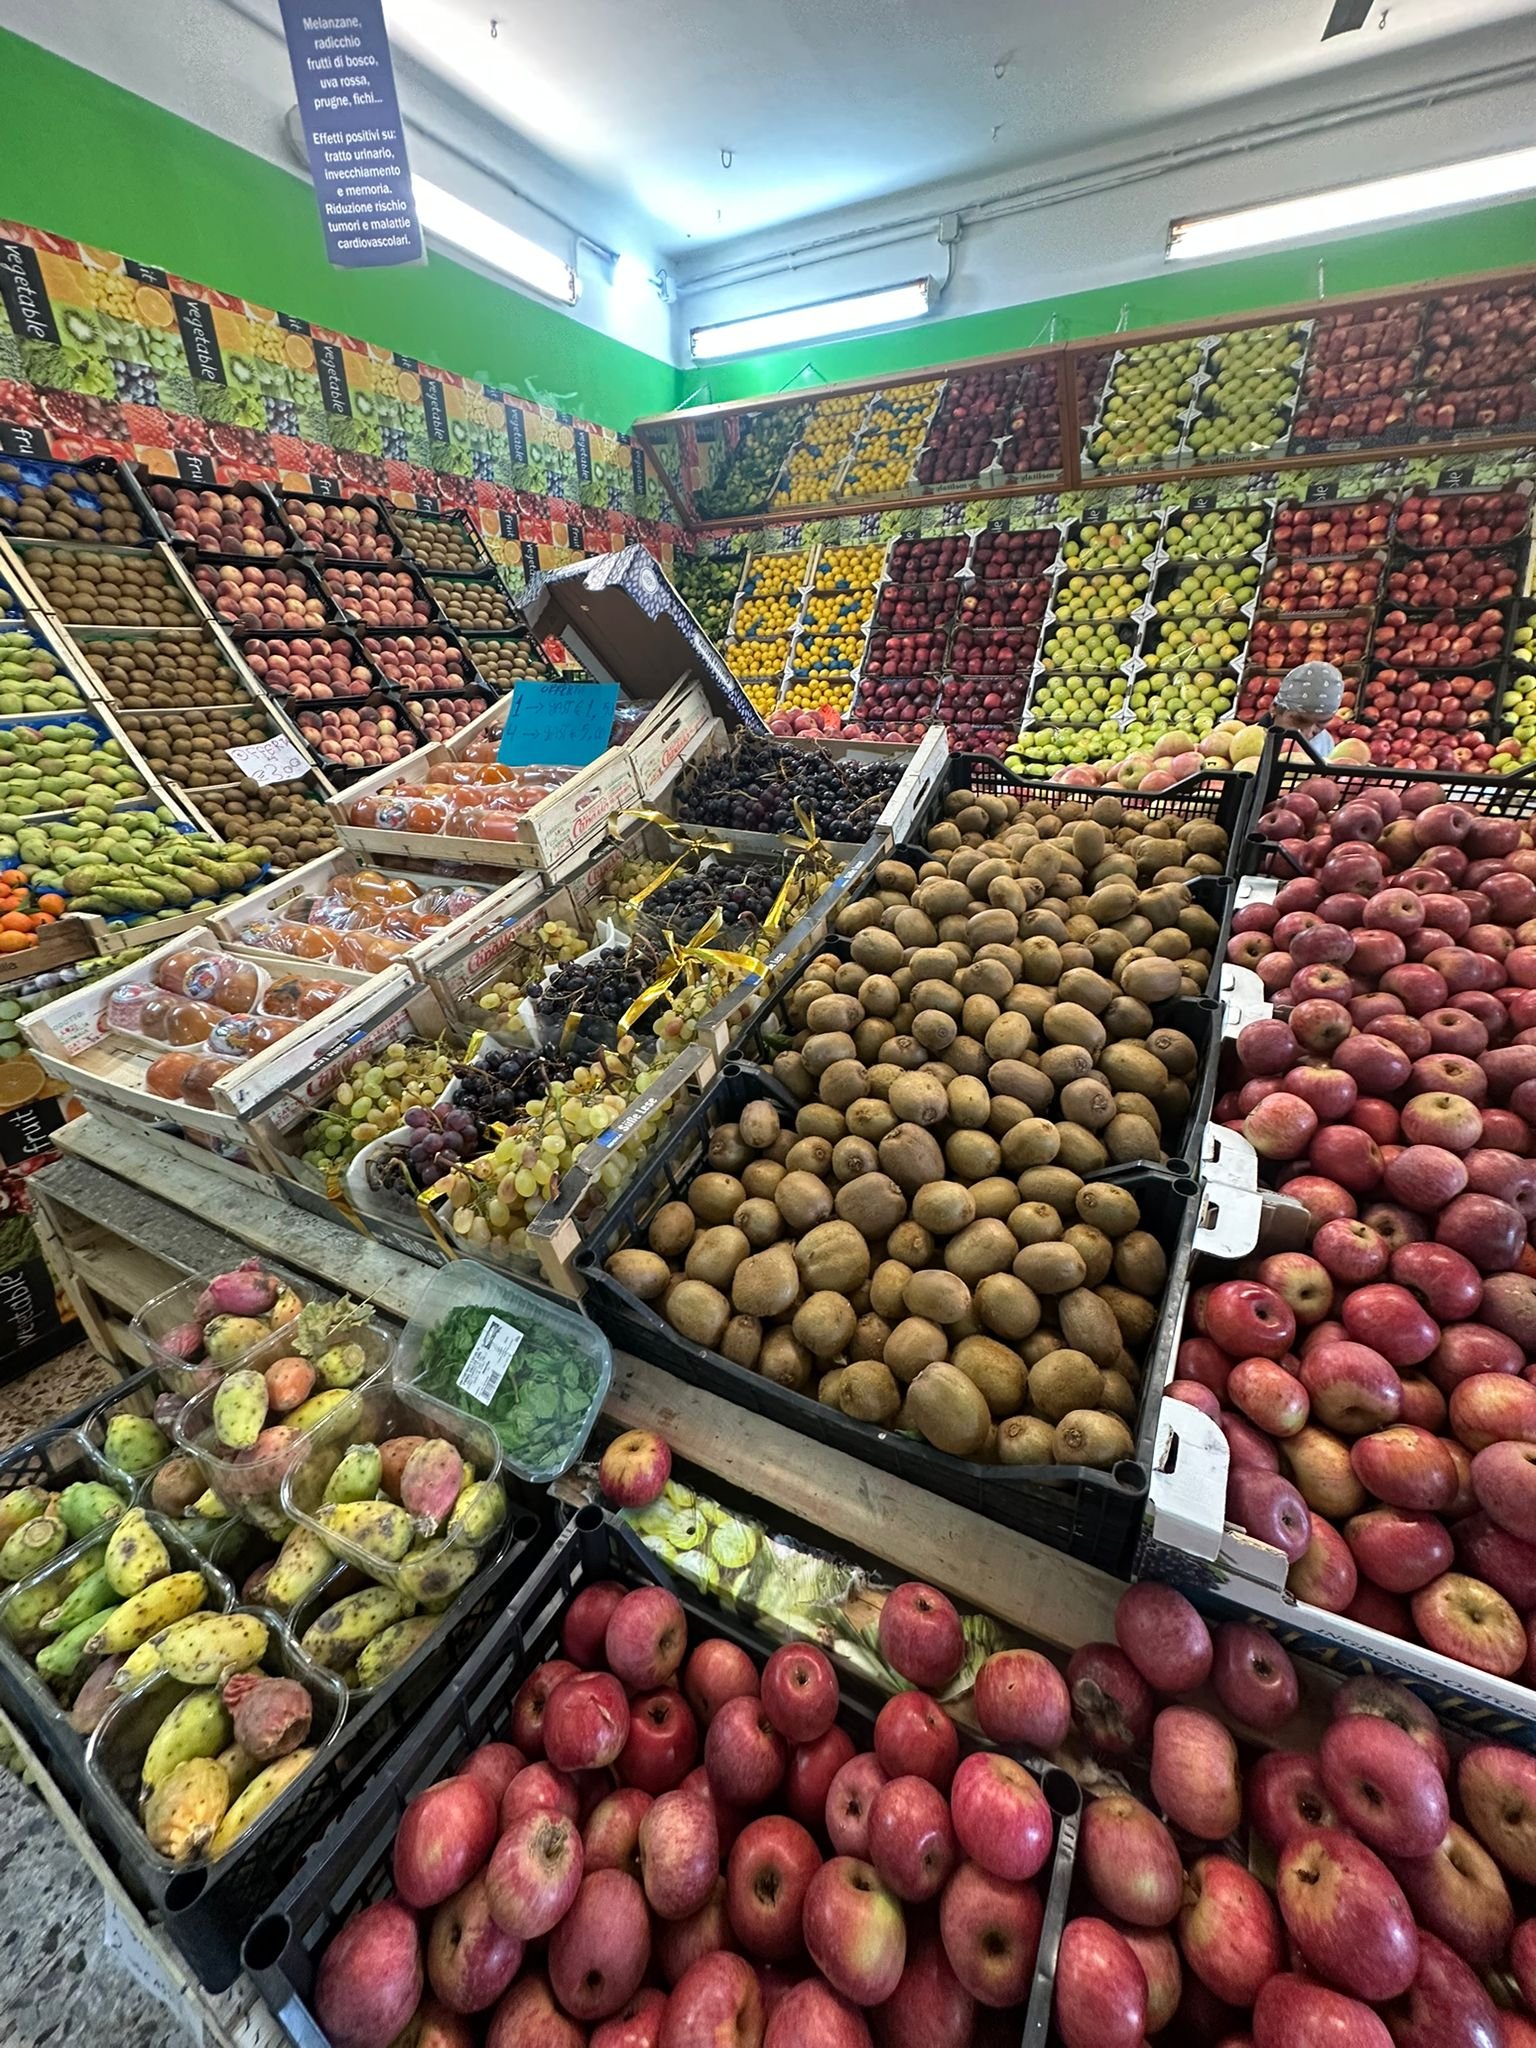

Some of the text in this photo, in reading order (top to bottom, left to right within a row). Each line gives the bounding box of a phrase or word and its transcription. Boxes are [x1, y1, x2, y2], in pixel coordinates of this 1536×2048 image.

[303, 17, 363, 31] Melanzane,
[314, 36, 361, 50] radicchio
[307, 53, 379, 71] frutti di bosco,
[320, 75, 370, 89] uva rossa,
[314, 92, 383, 111] prugne, fichi...
[313, 128, 397, 145] Effetti positivi su:
[325, 149, 352, 163] tratto
[325, 166, 400, 180] invecchiamento
[337, 187, 344, 197] e
[325, 198, 407, 215] Riduzione rischio
[328, 215, 411, 233] tumori e malattie
[338, 233, 411, 249] cardiovascolari.
[4, 244, 49, 339] vegetable
[183, 301, 216, 380] vegetable
[320, 345, 345, 413] vegetable
[428, 380, 444, 439] vegetable
[510, 408, 524, 462] vegetable
[576, 431, 590, 483] vegetable
[503, 514, 515, 538] fruit
[618, 1097, 658, 1132] Süße Lese
[9, 1109, 50, 1153] fruit
[1315, 1627, 1439, 1679] INGROSSO
